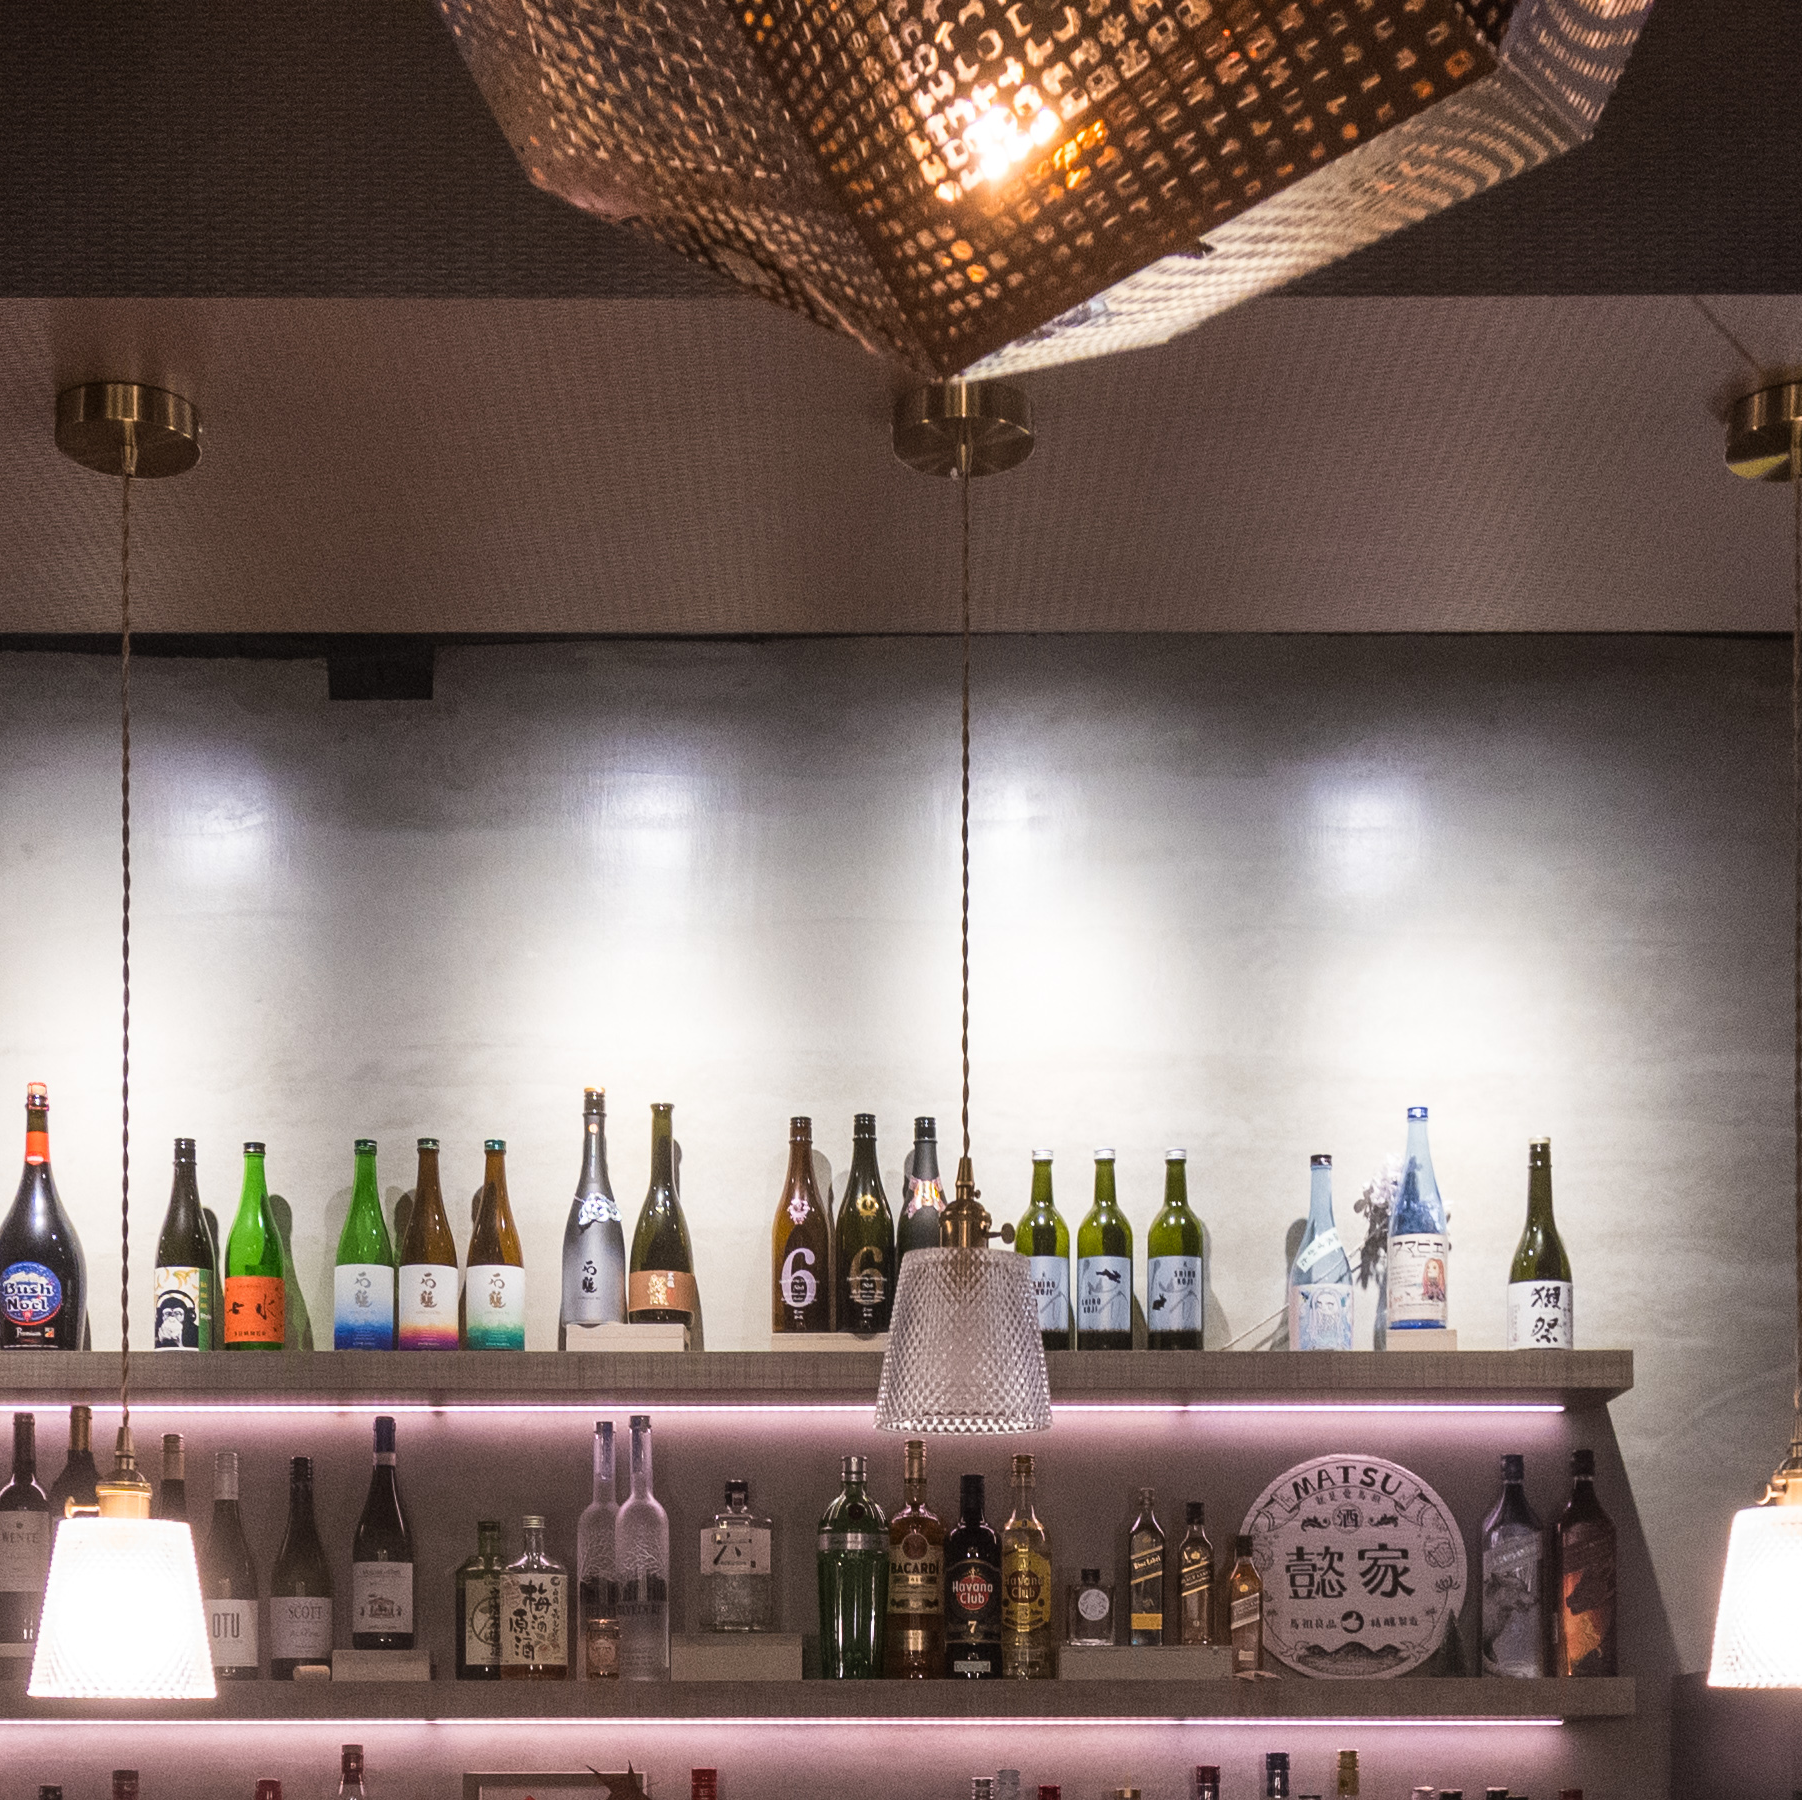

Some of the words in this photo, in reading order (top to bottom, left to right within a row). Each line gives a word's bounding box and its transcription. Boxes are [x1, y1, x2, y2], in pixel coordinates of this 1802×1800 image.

[1392, 1240, 1445, 1257] アマビエ
[781, 1247, 817, 1308] 6
[849, 1246, 884, 1306] 6
[3, 1283, 54, 1297] Bush
[1531, 1285, 1561, 1344] 獺祭
[1292, 1465, 1403, 1500] MATSU
[1337, 1508, 1359, 1528] 酒
[2, 1532, 39, 1543] WENTE
[1146, 1555, 1161, 1566] Label
[1285, 1543, 1416, 1600] 懿家
[952, 1580, 994, 1594] Havana
[959, 1593, 985, 1604] Club
[288, 1606, 323, 1621] SCOTT
[212, 1613, 240, 1638] OTU
[967, 1619, 977, 1634] 7
